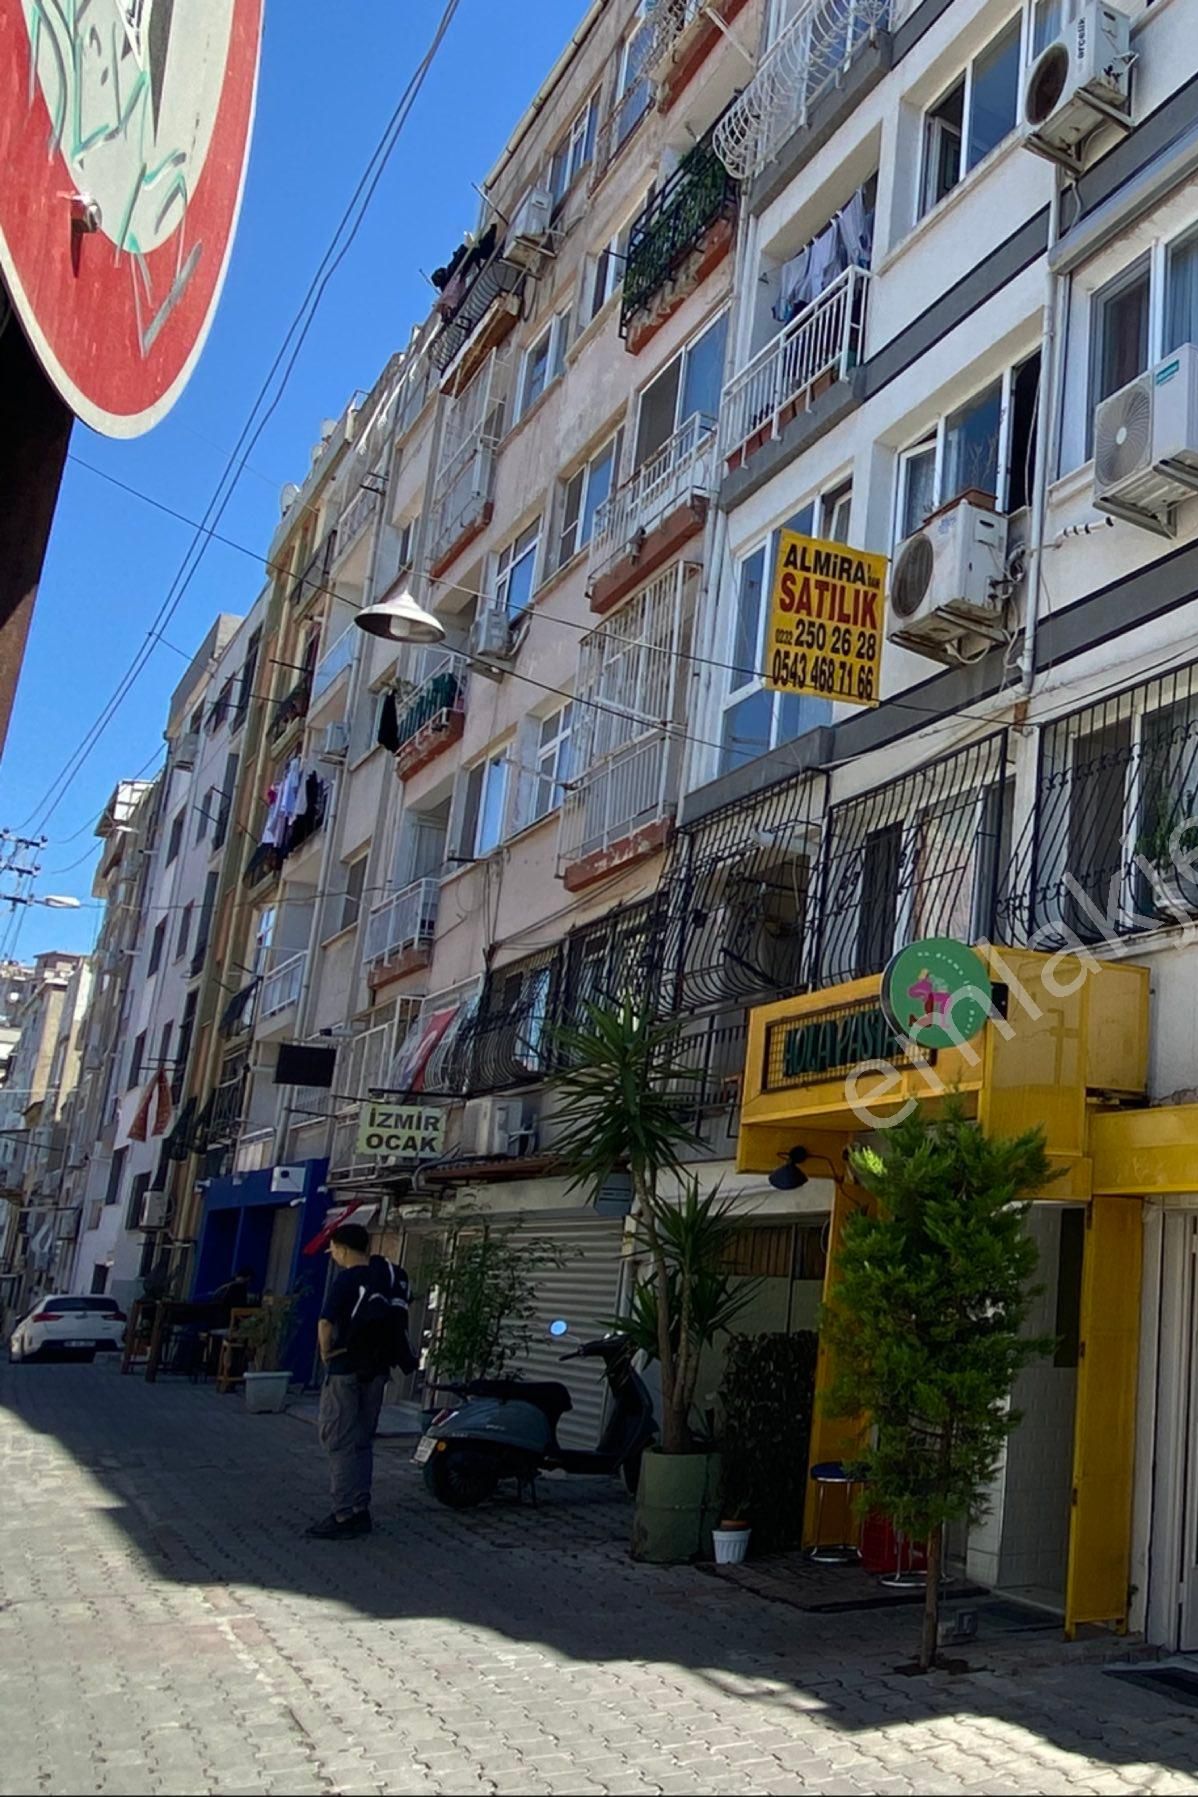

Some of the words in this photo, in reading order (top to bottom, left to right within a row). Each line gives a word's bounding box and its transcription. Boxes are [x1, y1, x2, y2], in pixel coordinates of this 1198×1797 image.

[779, 572, 878, 630] SATILIK
[794, 618, 827, 651] 250
[830, 626, 852, 656] 26
[856, 631, 877, 661] 28
[772, 648, 807, 689] 0543
[811, 655, 835, 694] 468
[839, 660, 853, 696] 71
[857, 665, 874, 700] 66
[368, 1107, 440, 1132] İZMİR
[365, 1133, 438, 1153] OCAK
